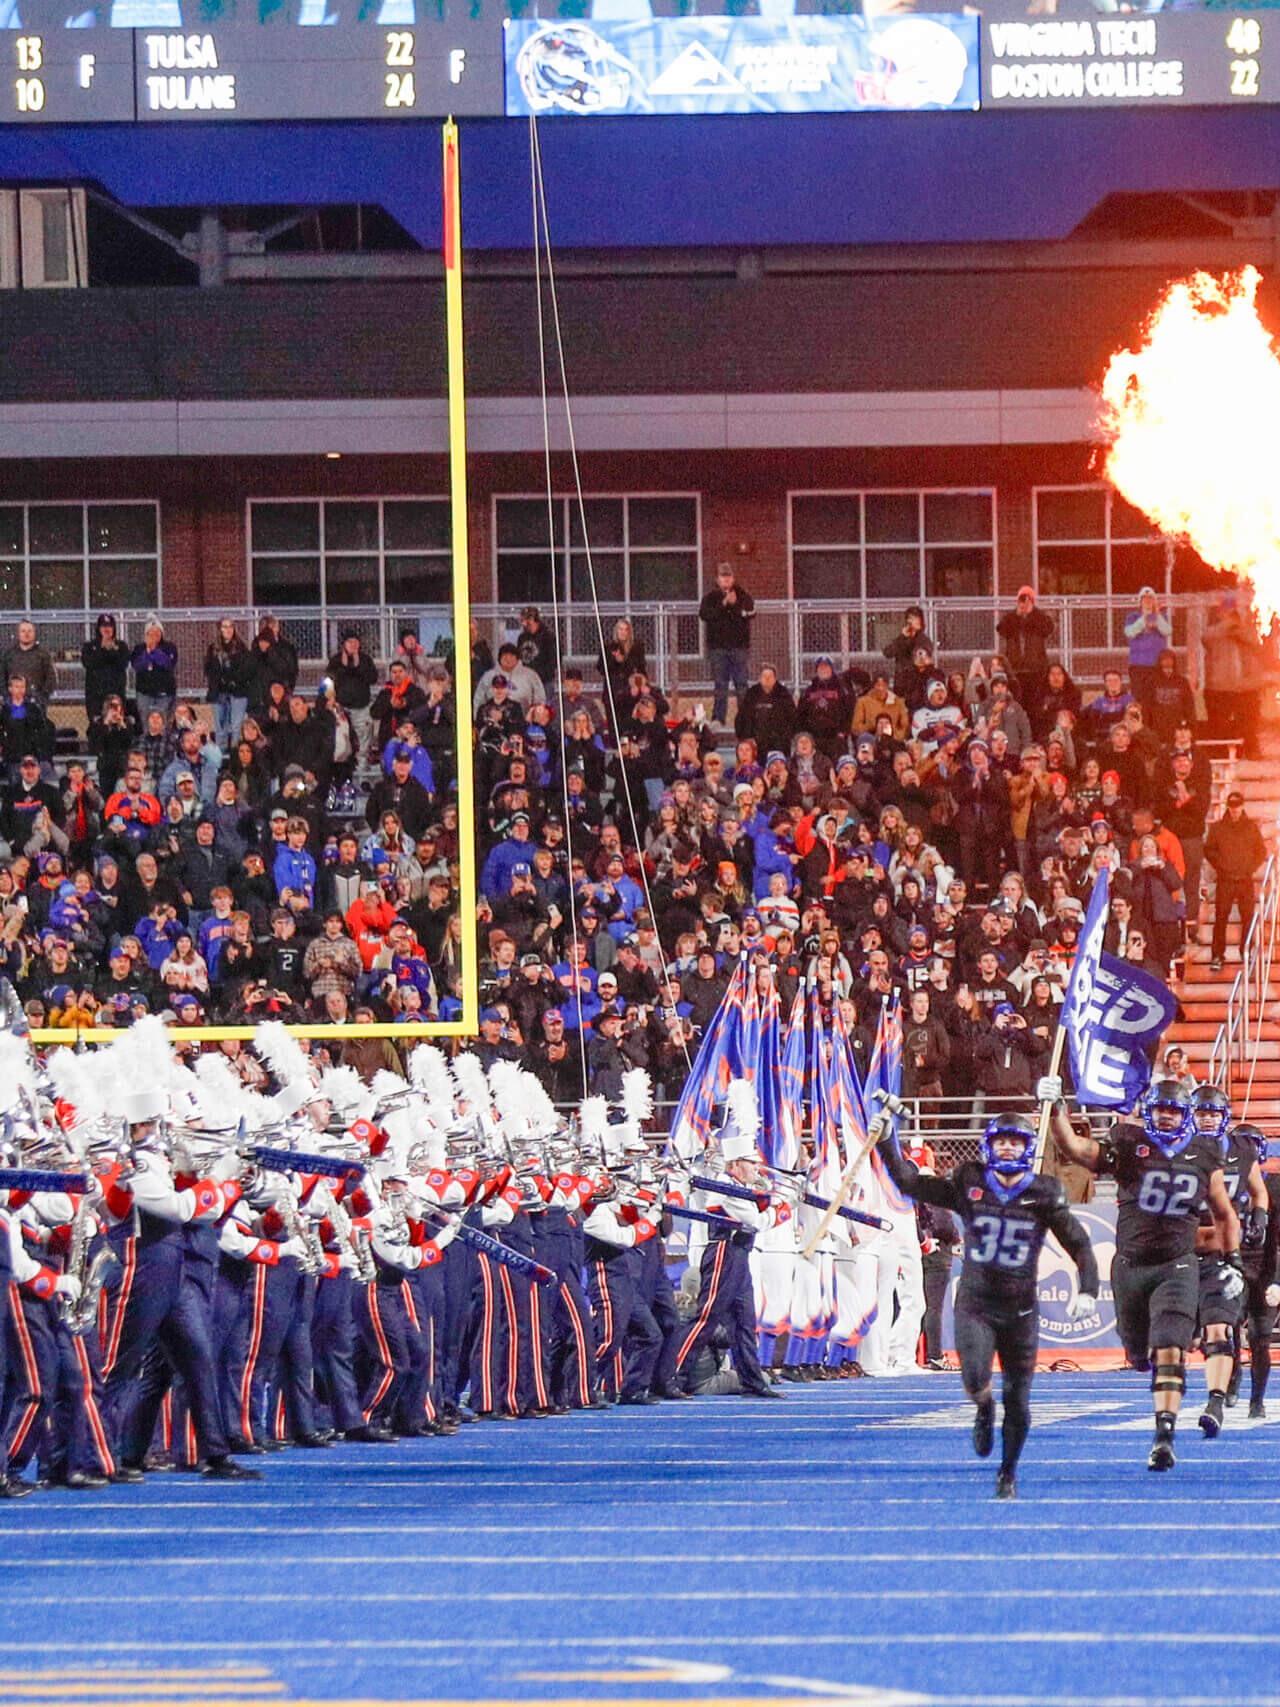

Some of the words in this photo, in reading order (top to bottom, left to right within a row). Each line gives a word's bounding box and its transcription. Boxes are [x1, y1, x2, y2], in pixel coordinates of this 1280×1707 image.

[16, 36, 42, 71] 13
[145, 34, 219, 69] TULSA
[386, 32, 415, 66] 22
[989, 21, 1096, 58] VIRGINIA
[1097, 19, 1158, 56] TECH
[79, 54, 96, 89] F
[449, 49, 466, 84] F
[991, 63, 1085, 98] BOSTON
[1085, 60, 1184, 96] COLLEGE
[1229, 59, 1261, 96] 22
[16, 78, 45, 112] 10
[145, 75, 237, 111] TULANE
[385, 72, 416, 107] 24
[282, 953, 293, 971] 2
[1138, 1169, 1199, 1216] 62
[969, 1215, 1036, 1267] 35
[1038, 1313, 1102, 1336] ompany
